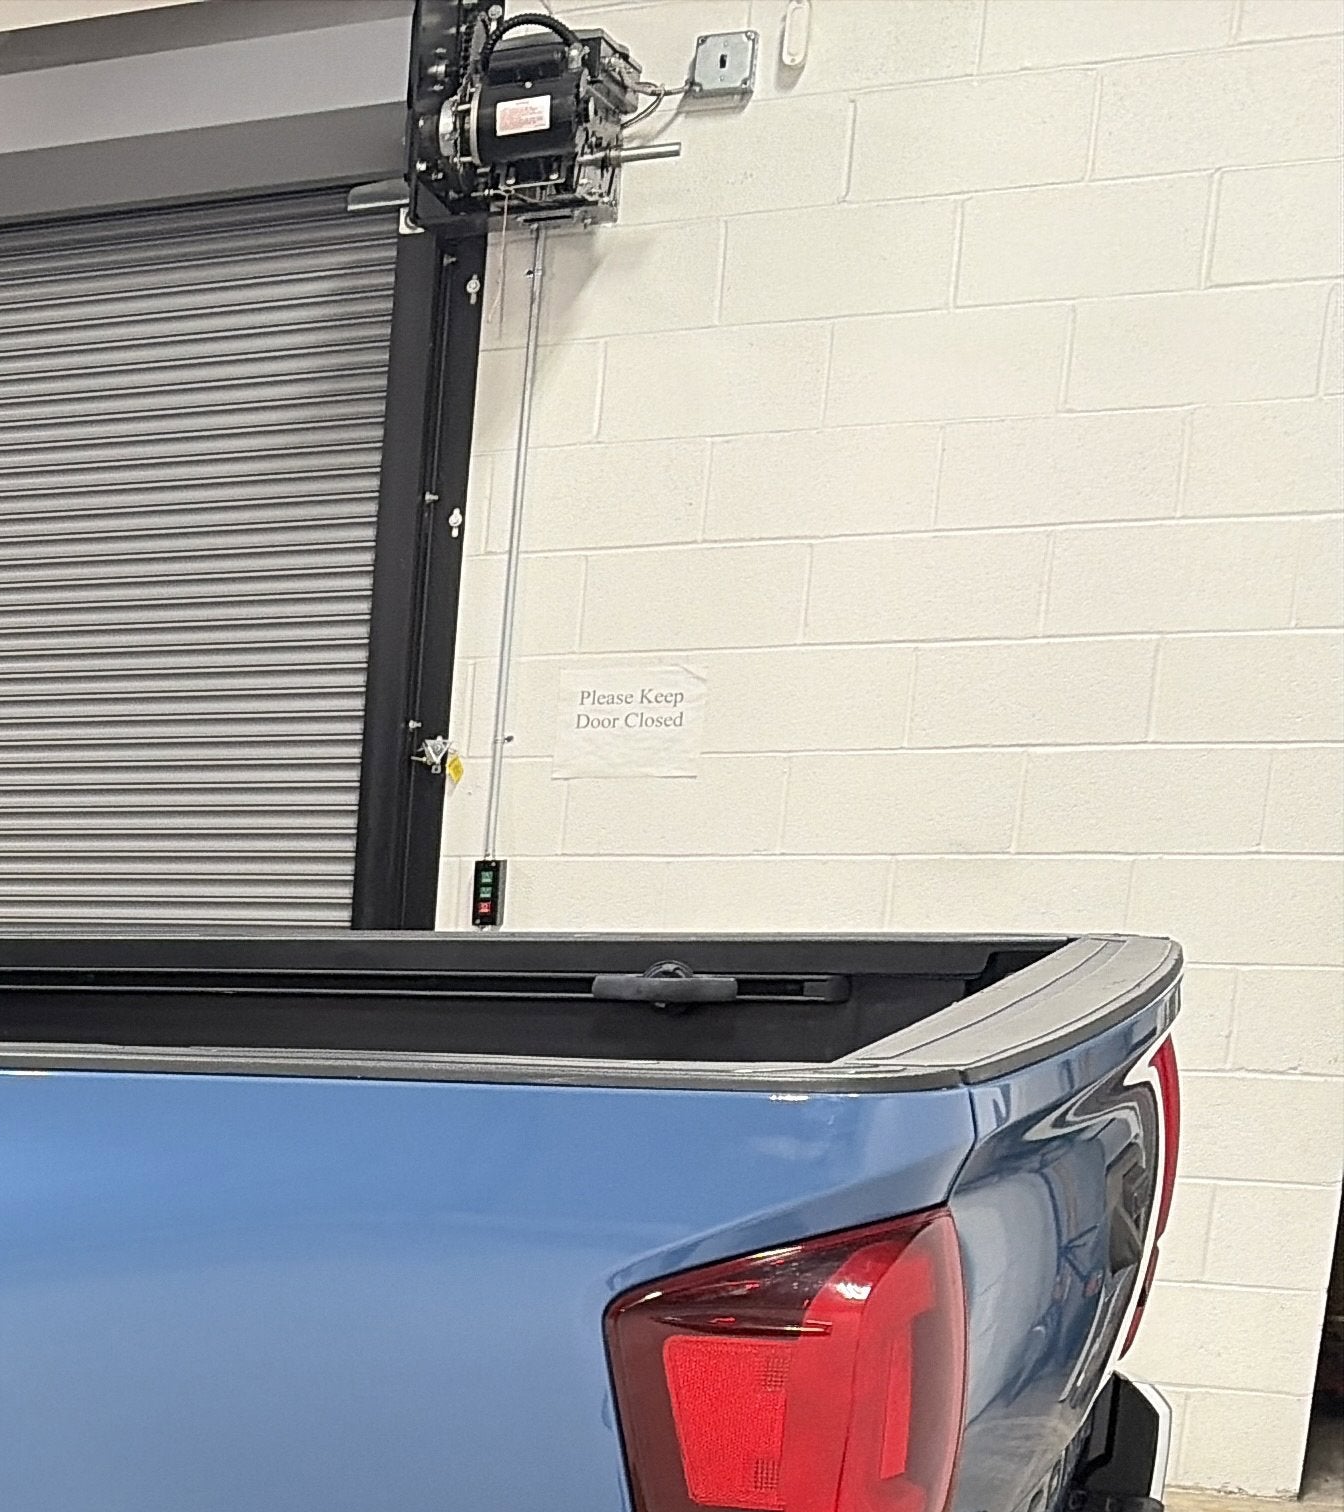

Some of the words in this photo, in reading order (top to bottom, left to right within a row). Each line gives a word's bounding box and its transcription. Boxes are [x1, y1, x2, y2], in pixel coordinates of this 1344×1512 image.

[578, 689, 634, 706] Please
[639, 688, 685, 707] Keep
[575, 713, 620, 729] Door
[624, 711, 684, 728] Closed
